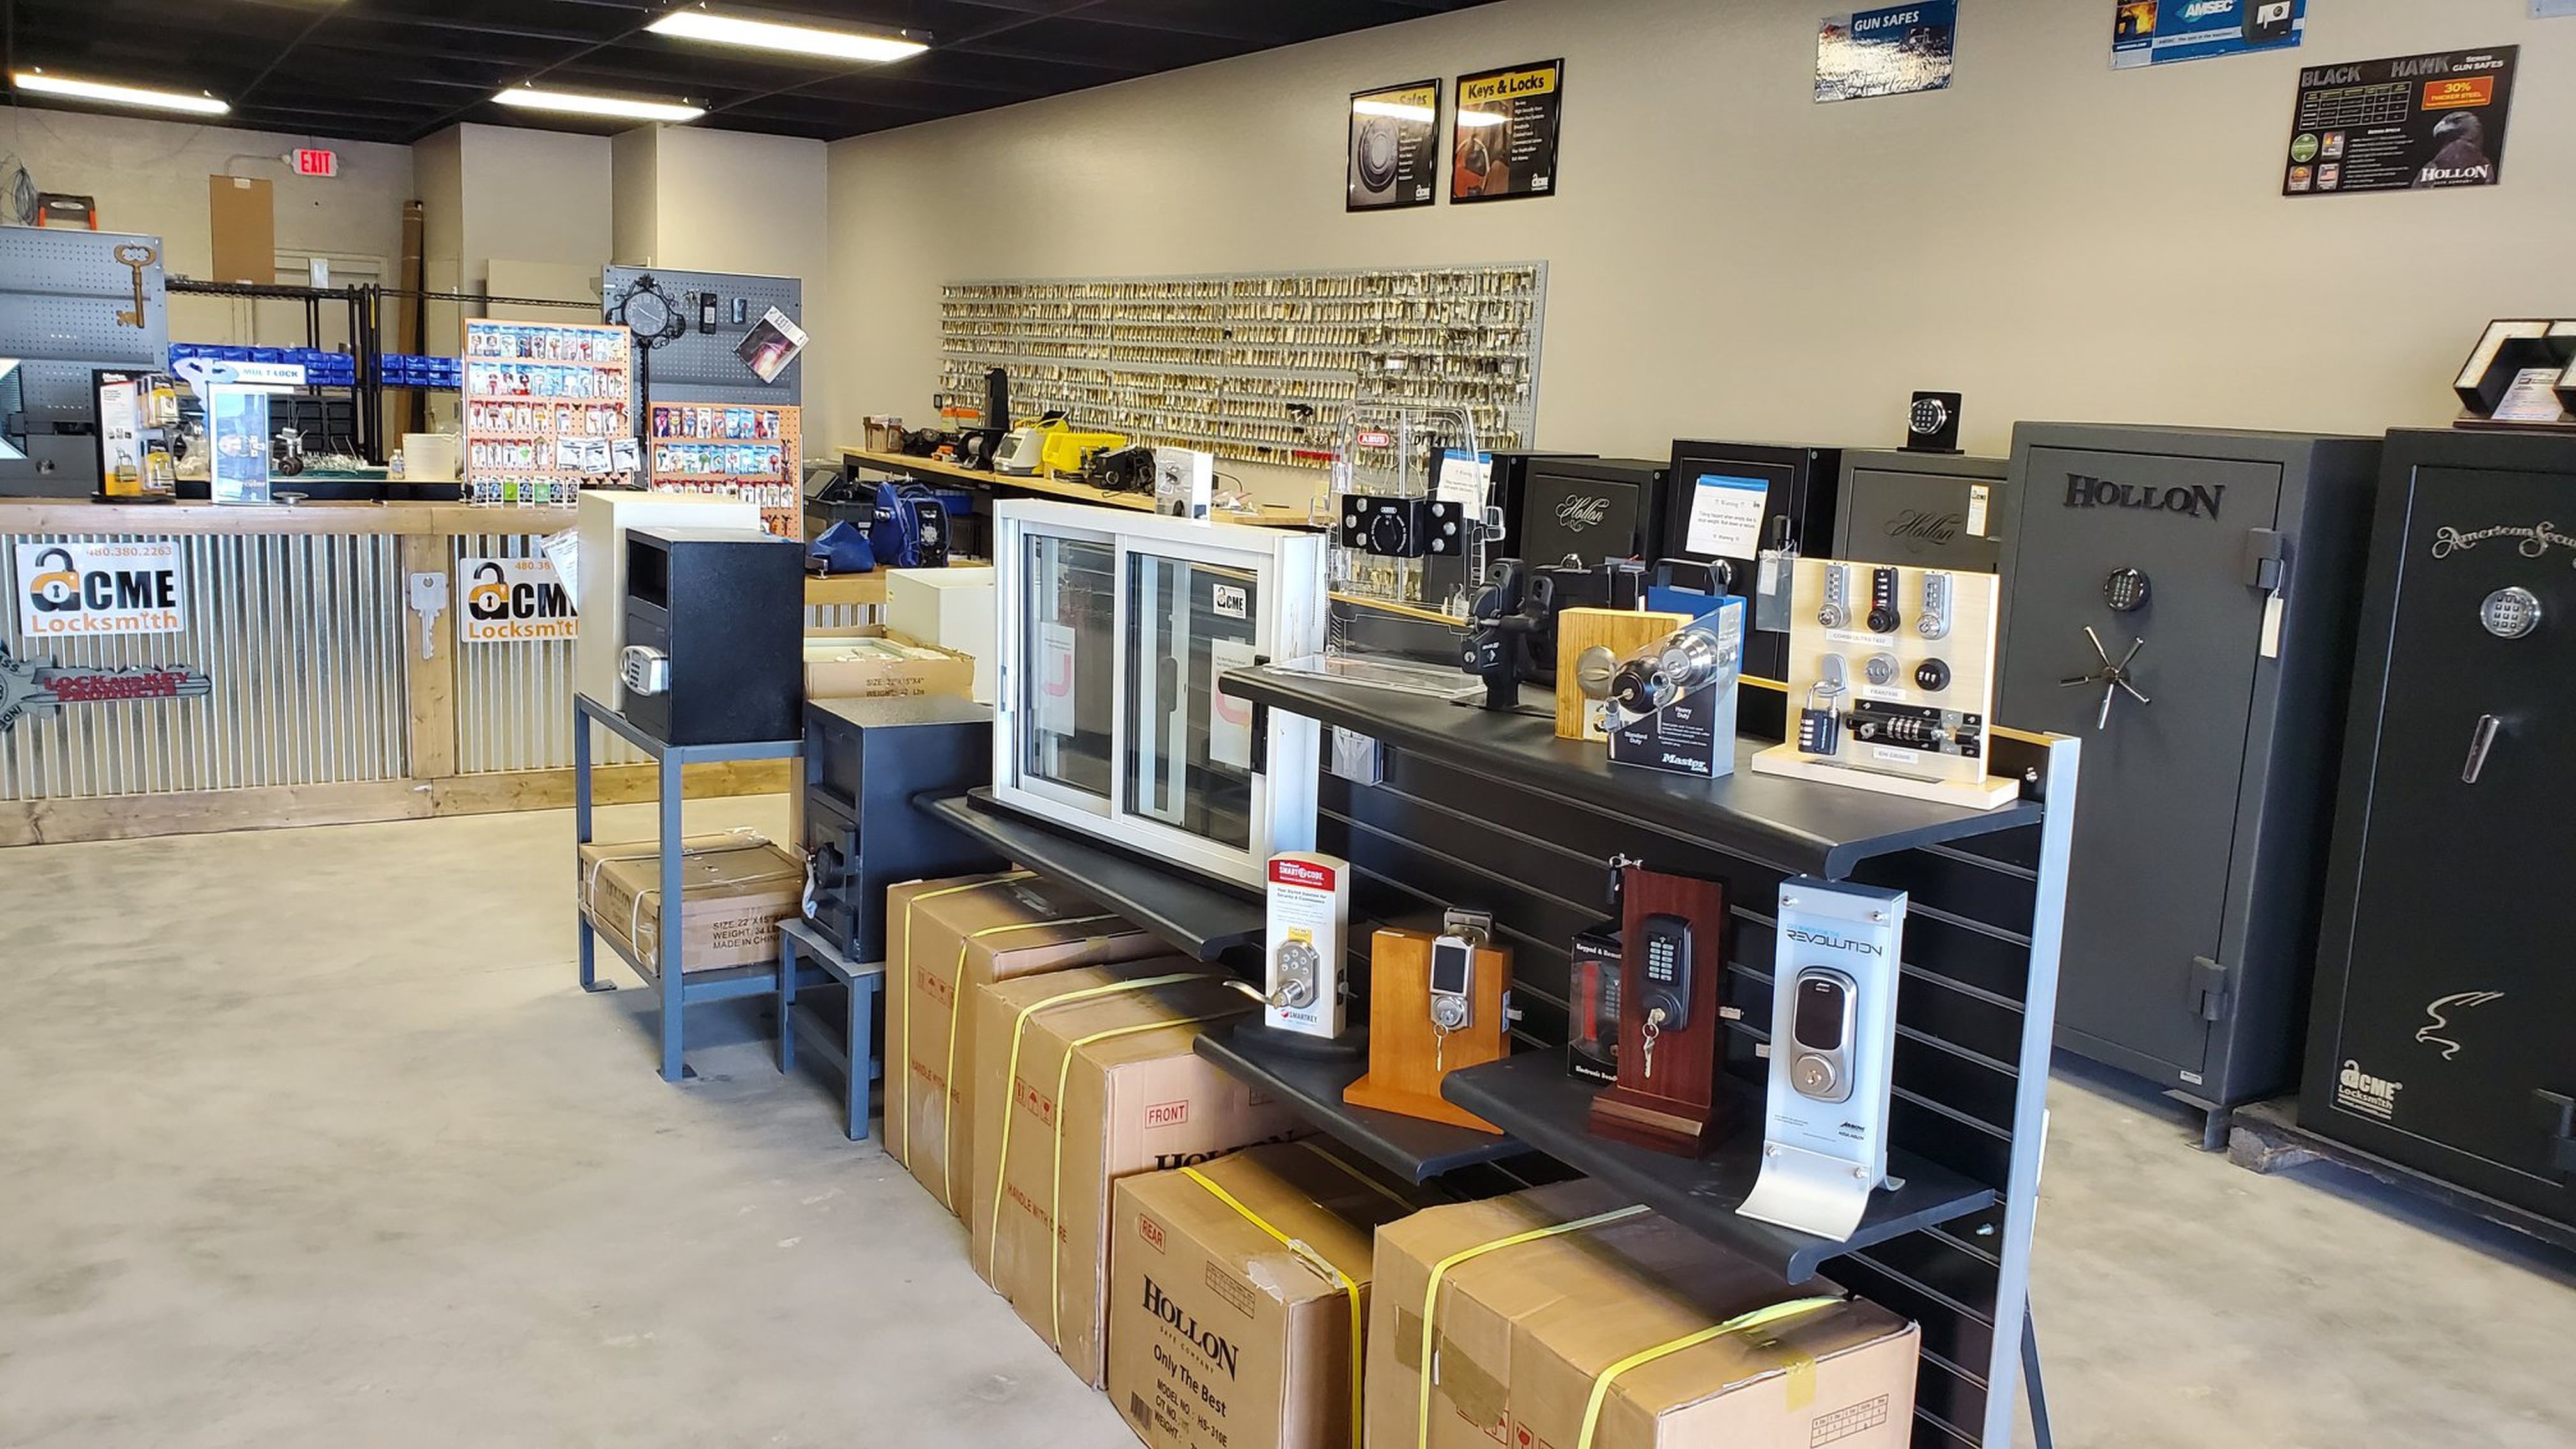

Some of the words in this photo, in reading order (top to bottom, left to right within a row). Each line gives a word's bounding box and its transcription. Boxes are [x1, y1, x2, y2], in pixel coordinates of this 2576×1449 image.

[1854, 17, 1881, 32] GUN
[1882, 10, 1919, 27] SAFES
[2185, 0, 2235, 18] AMSEC
[2301, 66, 2361, 88] BLACK
[2391, 56, 2451, 77] HAWK
[2474, 60, 2504, 70] SAFES
[1468, 82, 1494, 98] Keys
[1497, 80, 1506, 93] &
[1510, 75, 1544, 92] Locks
[2443, 82, 2472, 93] 30%
[301, 151, 330, 174] EXIT
[2420, 164, 2490, 183] HOLLON
[2064, 473, 2226, 521] HOLLON
[1556, 494, 1610, 532] Hollon
[1886, 509, 1961, 553] Hollon
[2432, 526, 2534, 559] American
[32, 610, 178, 633] Locksmith
[1676, 712, 1690, 721] Duty
[1662, 753, 1706, 768] Master
[713, 938, 740, 949] MADE
[742, 937, 752, 946] IN
[1576, 942, 1597, 954] Keypad
[1786, 929, 1882, 956] REVOLUTION
[2338, 1085, 2393, 1110] Locksmith
[1149, 1105, 1184, 1123] FRONT
[1008, 1181, 1031, 1213] HANDLE
[1033, 1205, 1048, 1227] WITH
[1050, 1218, 1067, 1244] CRE
[1141, 1219, 1163, 1247] REAR
[1143, 1274, 1239, 1383] HOLLON
[1181, 1343, 1214, 1374] COMPANY
[1154, 1344, 1177, 1377] Only
[1180, 1365, 1199, 1394] The
[1202, 1384, 1226, 1418] Best
[1157, 1378, 1179, 1407] MODEL
